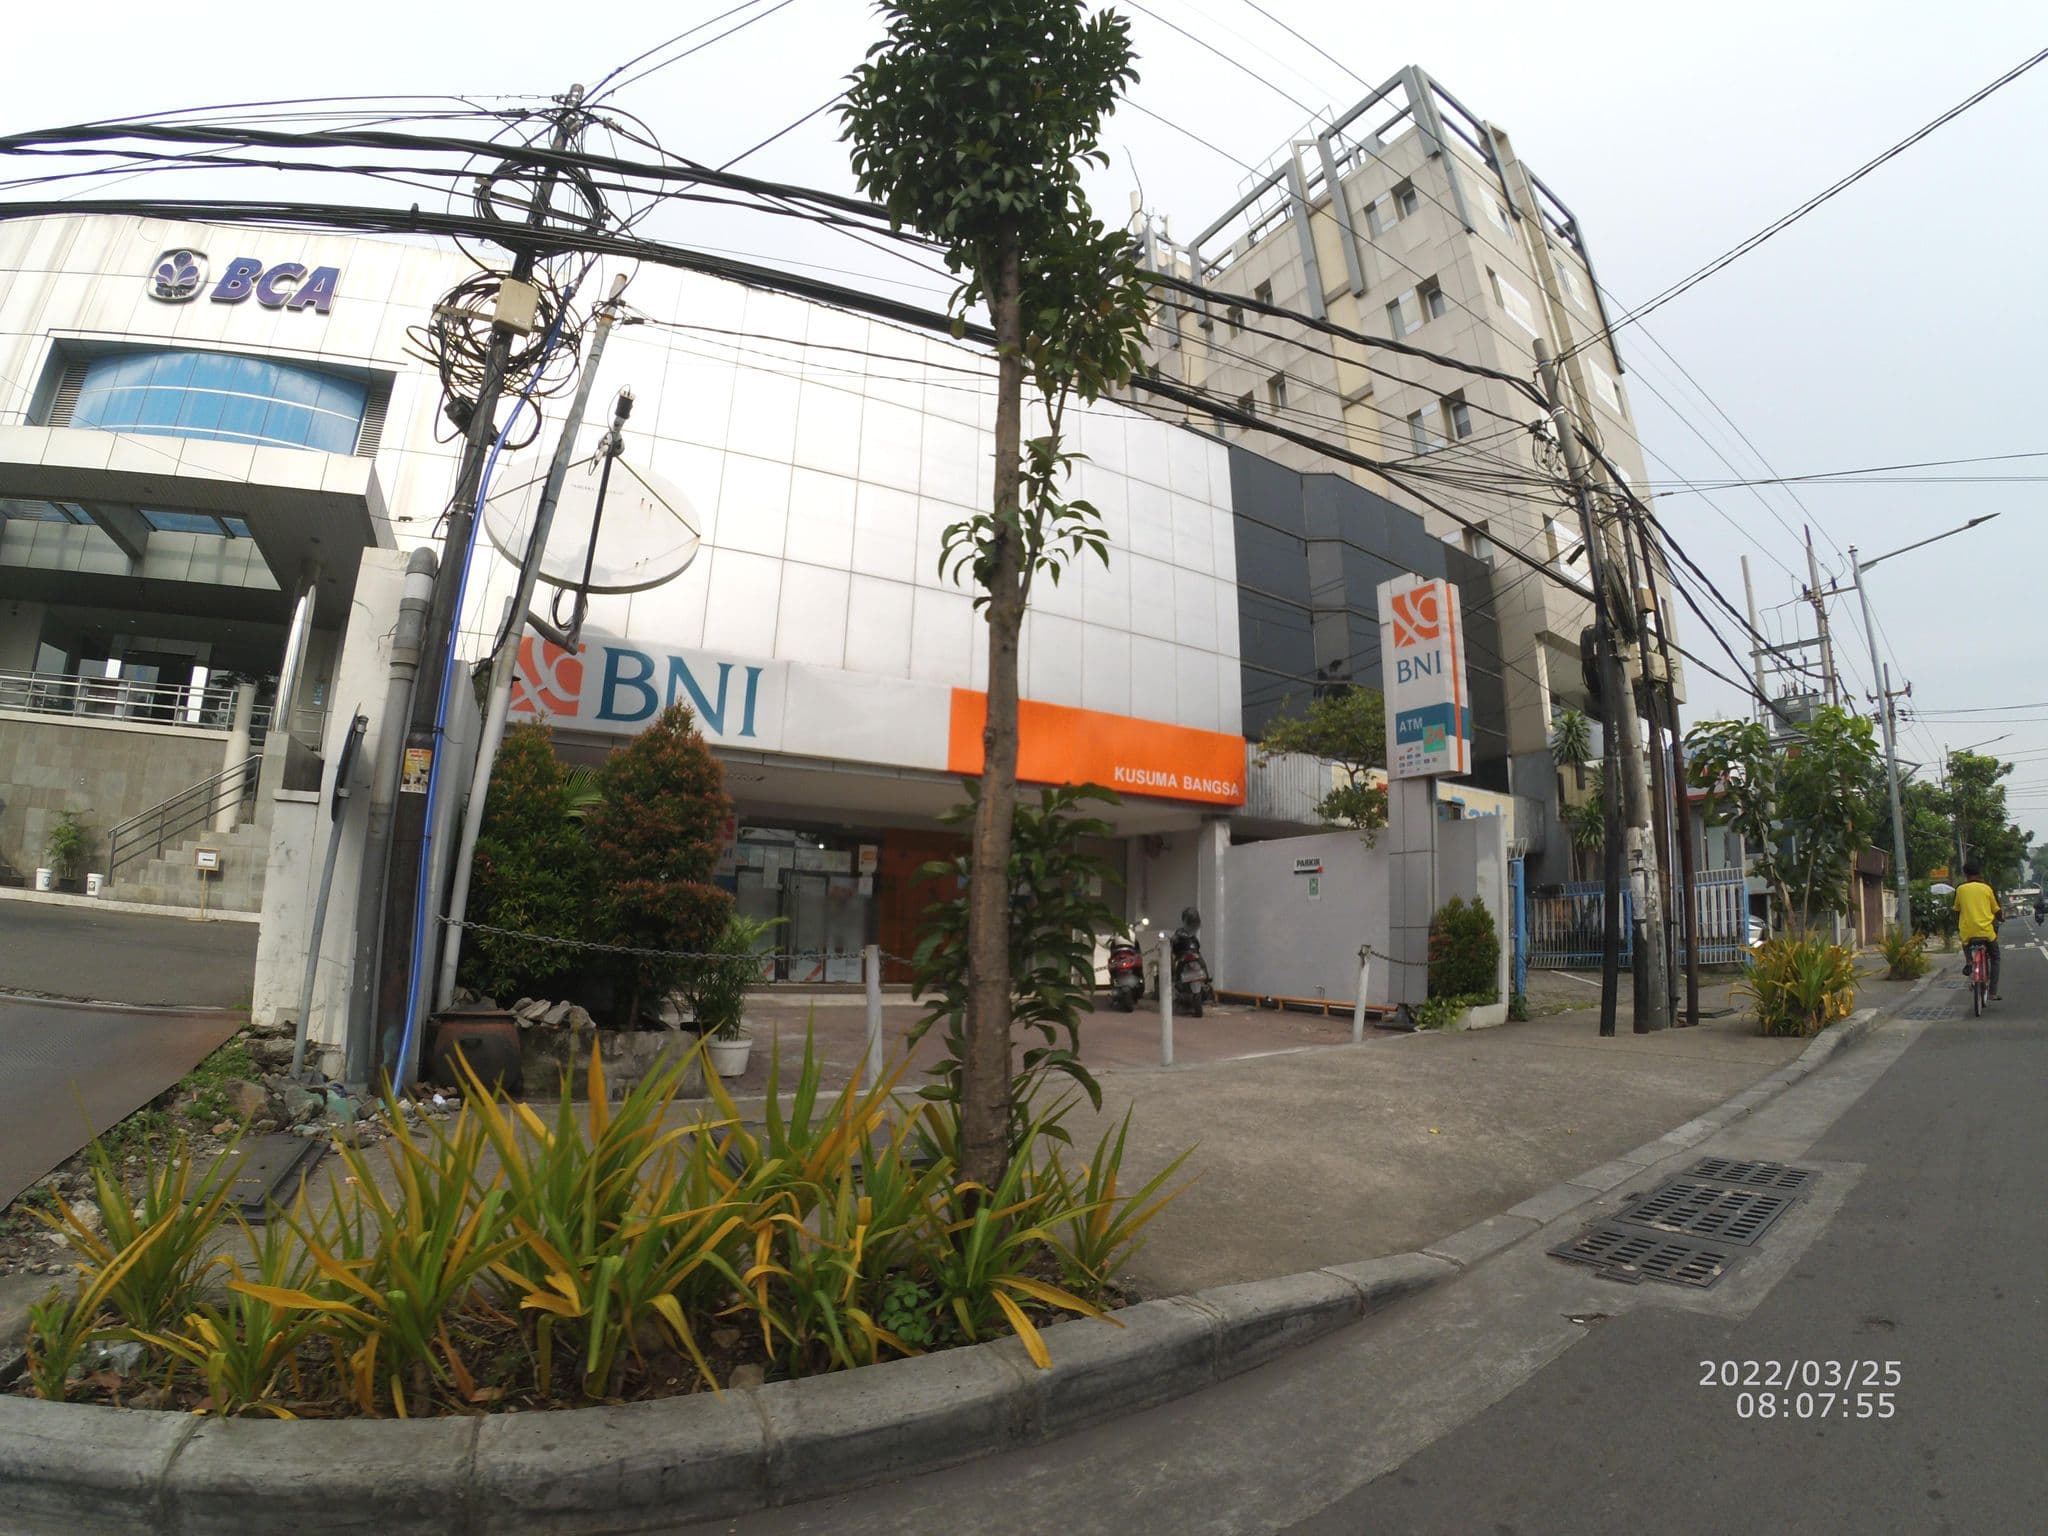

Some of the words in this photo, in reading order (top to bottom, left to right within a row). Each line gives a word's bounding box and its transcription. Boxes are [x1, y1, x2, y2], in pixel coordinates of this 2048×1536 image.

[210, 257, 341, 314] BCA
[1397, 650, 1441, 684] BNI
[594, 646, 763, 737] BNI
[1399, 716, 1423, 733] ATM
[1114, 766, 1178, 788] KUSUMA
[1183, 775, 1239, 797] BANGSA
